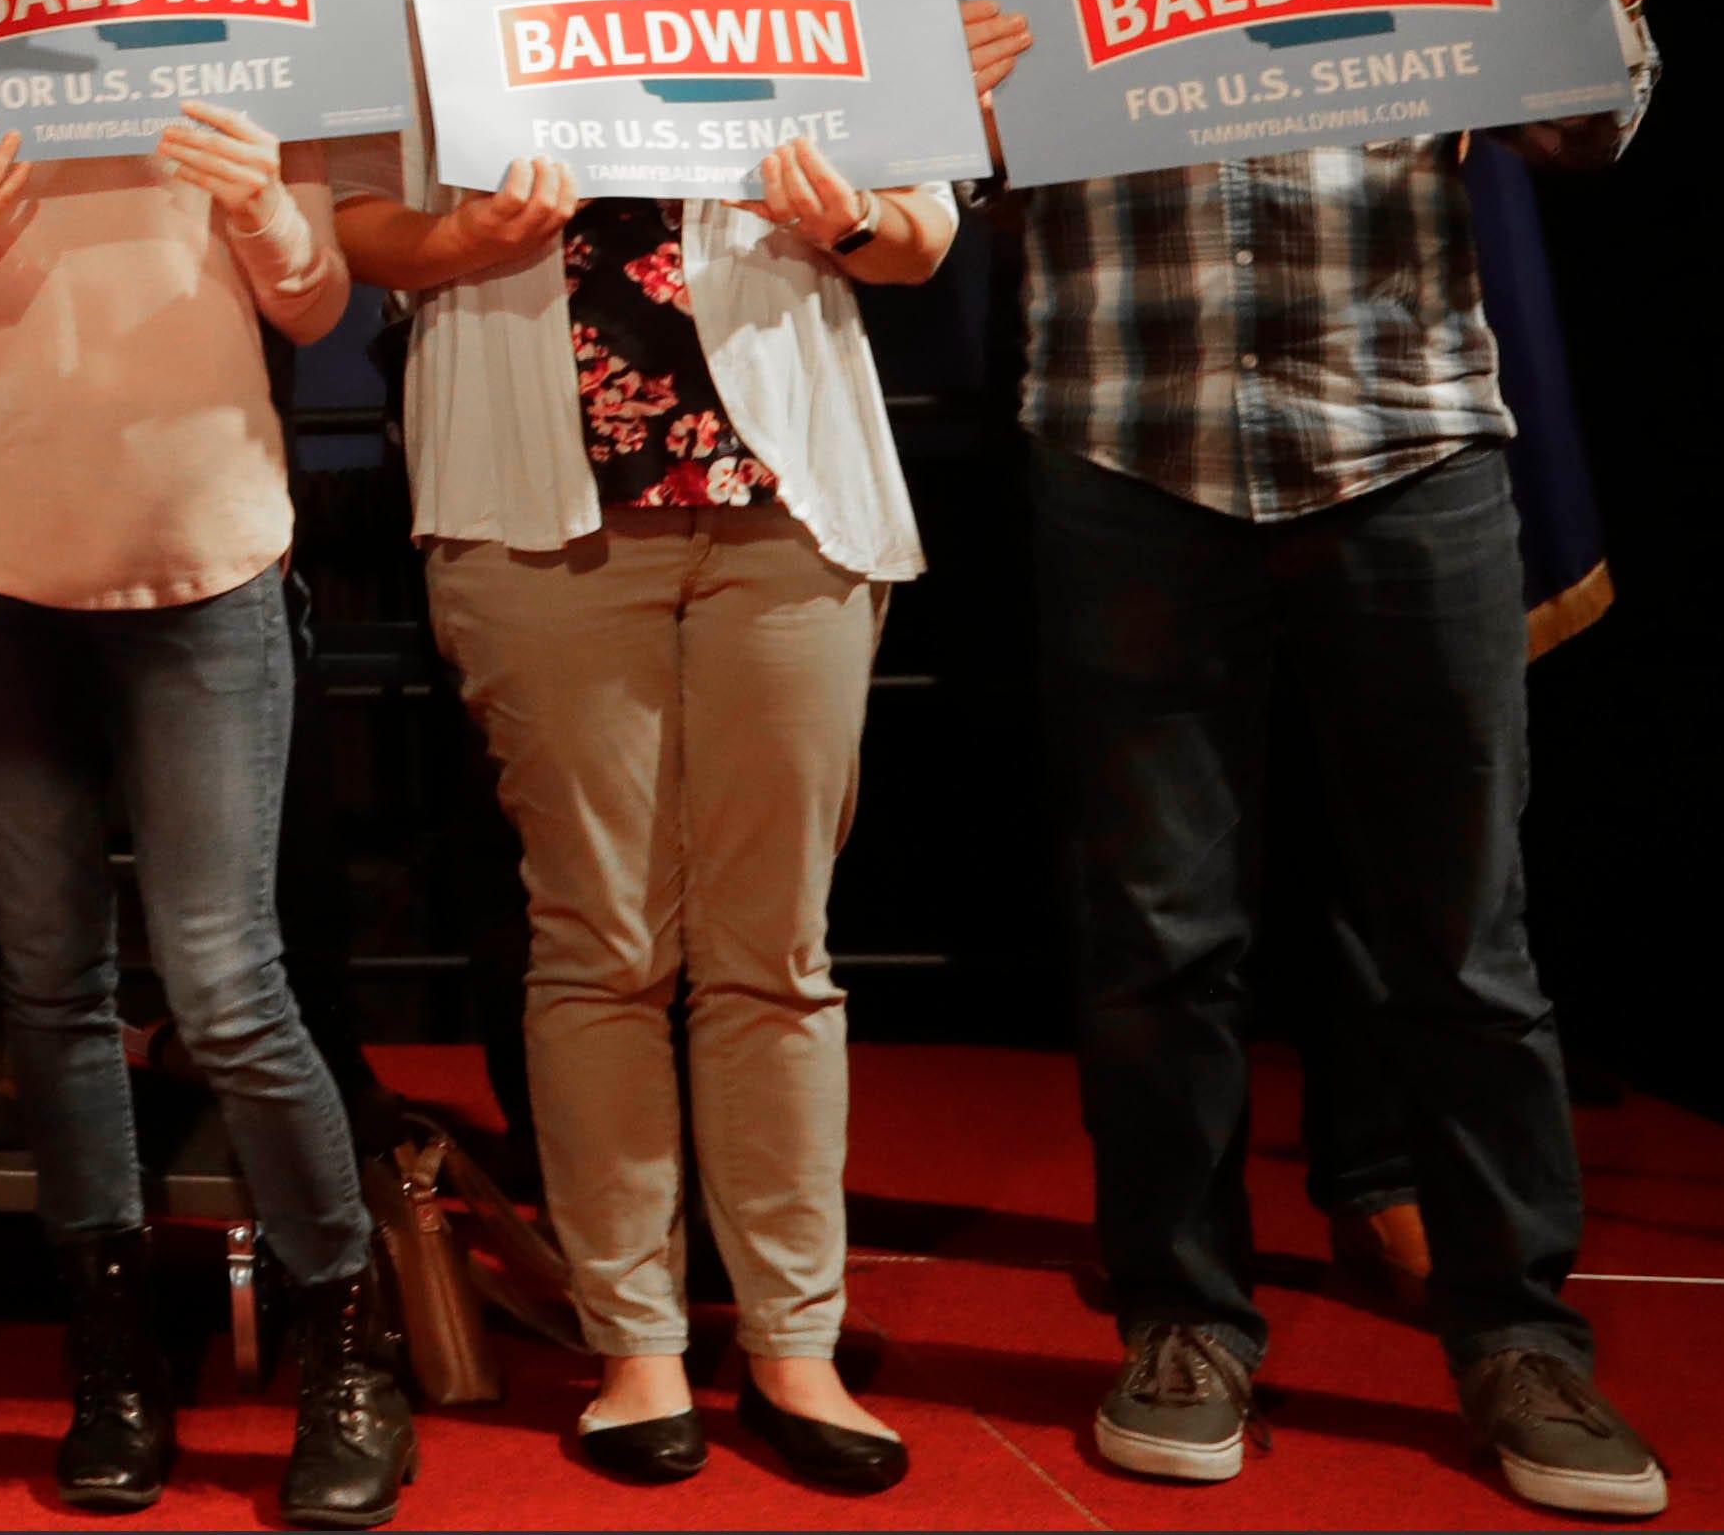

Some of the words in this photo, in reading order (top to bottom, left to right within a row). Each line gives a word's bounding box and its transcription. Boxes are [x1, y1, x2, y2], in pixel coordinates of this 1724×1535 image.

[513, 8, 850, 75] BALDWIN
[65, 68, 141, 106] U.S.
[150, 56, 294, 99] SENATE
[1125, 80, 1207, 121] FOR
[1218, 66, 1302, 107] U.S.
[1311, 41, 1479, 93] SENATE
[532, 118, 607, 150] FOR
[615, 119, 690, 150] U.S.
[699, 110, 850, 151] SENATE
[1187, 98, 1430, 147] TAMMYBALDWIN.COM
